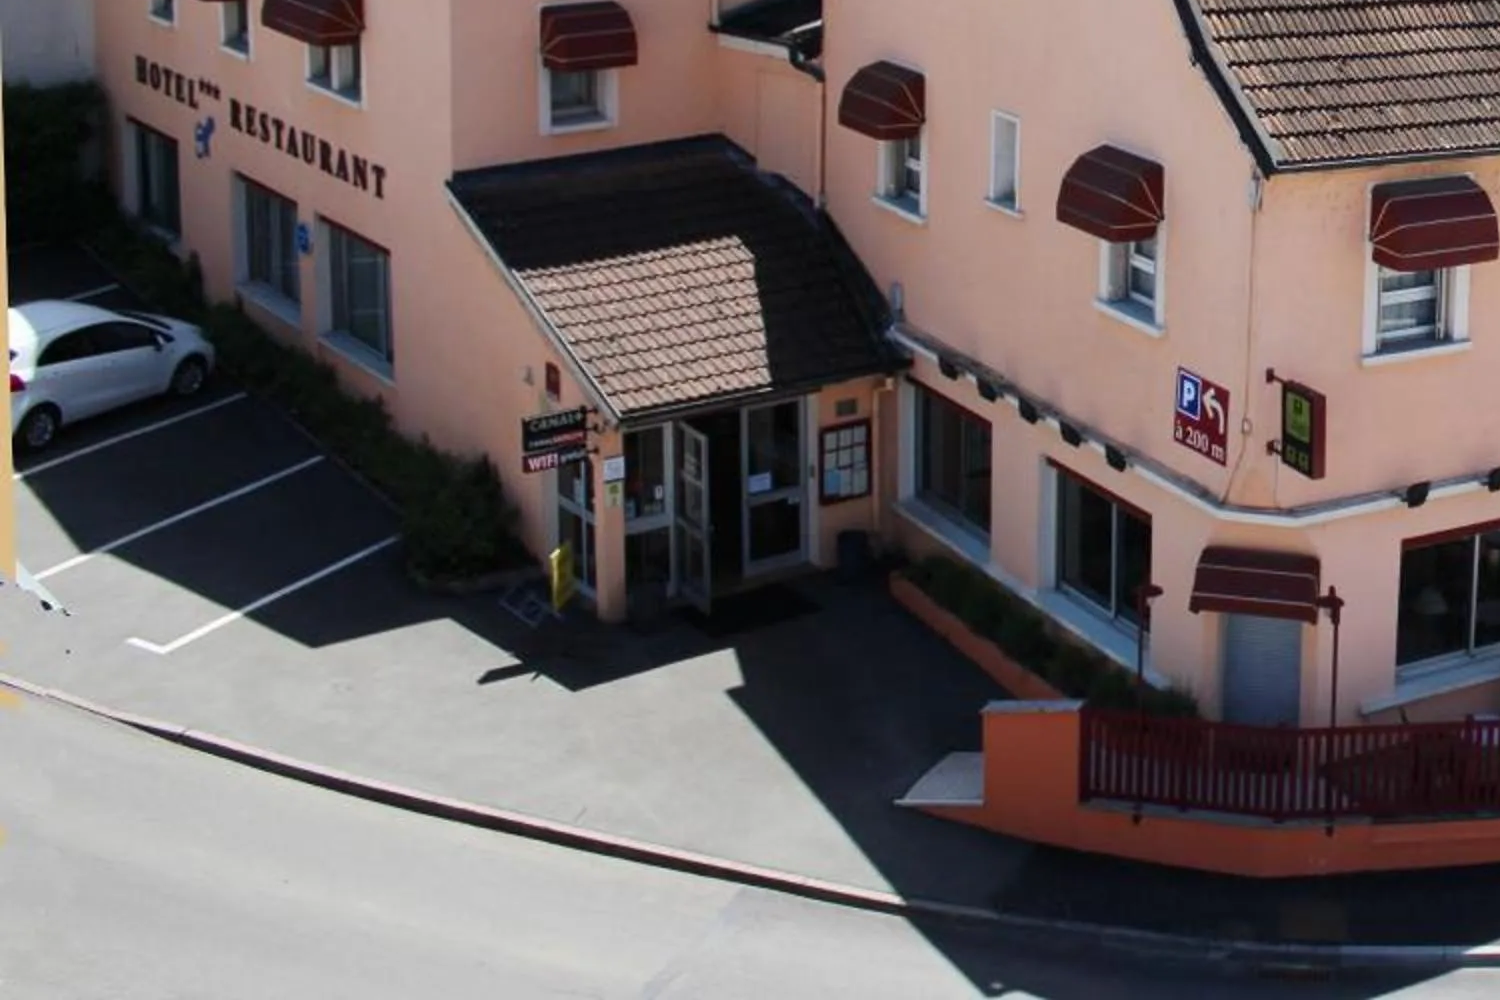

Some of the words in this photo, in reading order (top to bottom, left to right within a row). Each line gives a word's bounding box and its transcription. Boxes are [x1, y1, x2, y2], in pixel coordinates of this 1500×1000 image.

[229, 98, 387, 199] RESTAURANT
[1183, 381, 1195, 407] P
[1186, 426, 1209, 451] 200
[1211, 442, 1224, 461] m
[528, 453, 558, 471] WIFI
